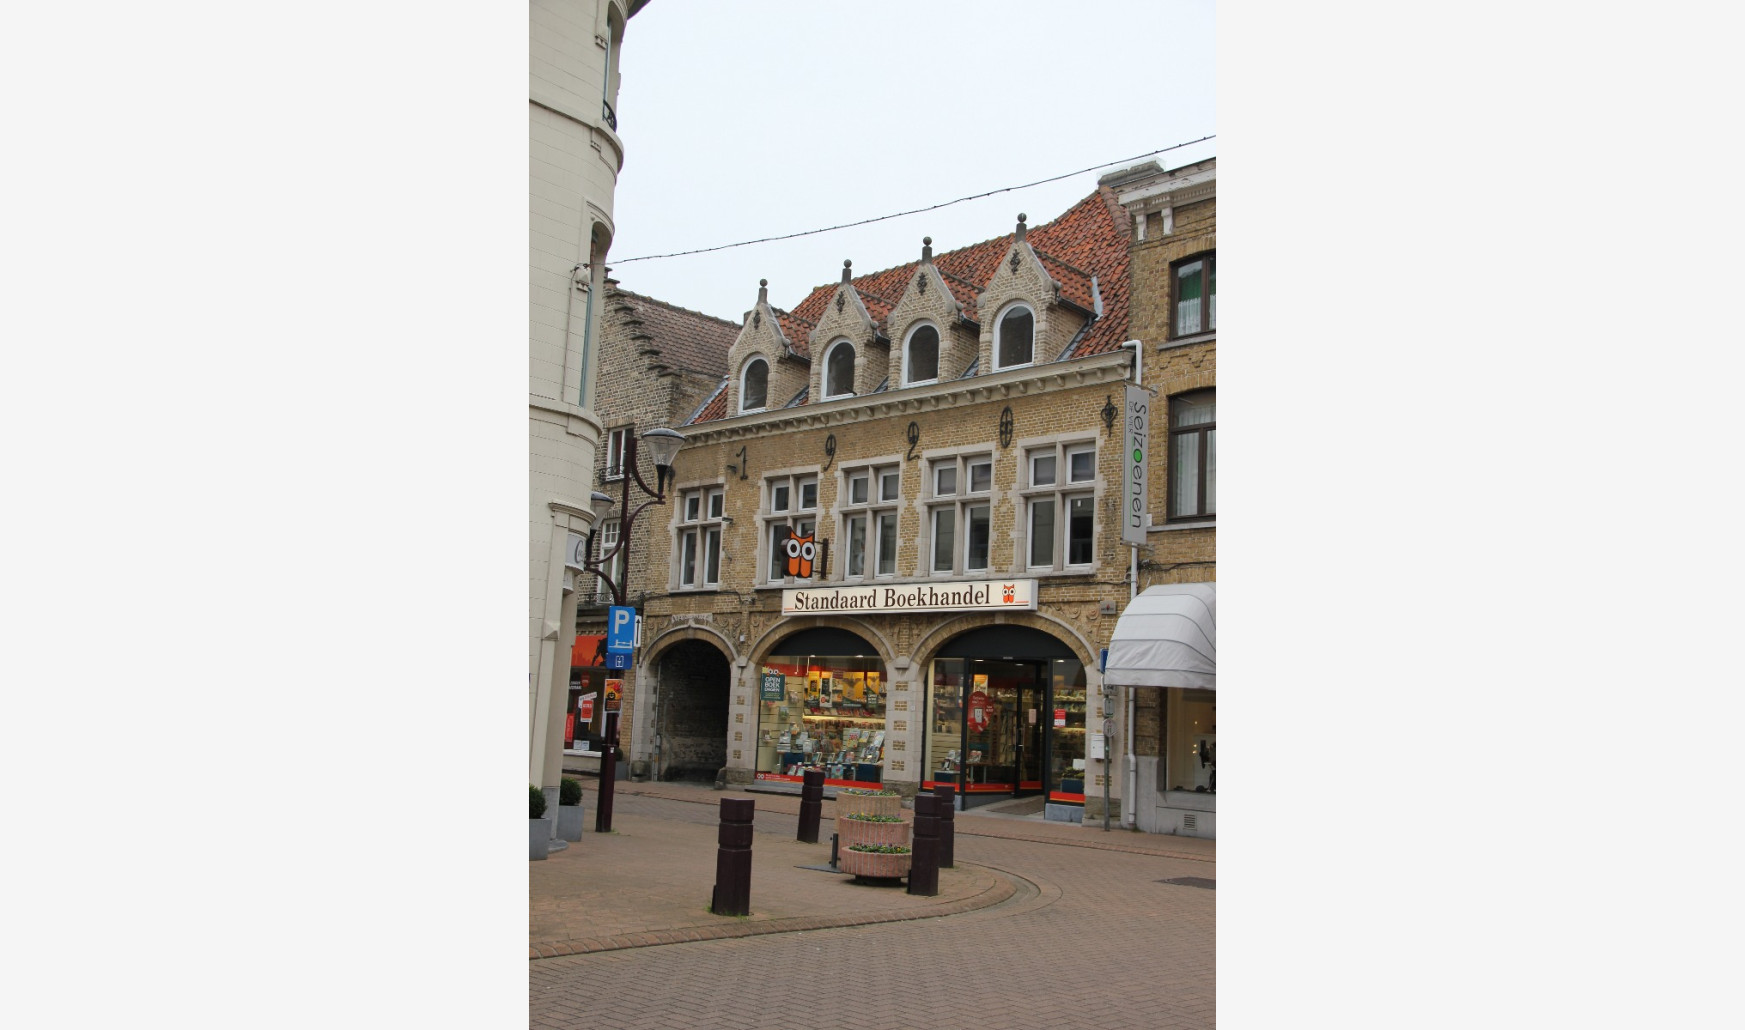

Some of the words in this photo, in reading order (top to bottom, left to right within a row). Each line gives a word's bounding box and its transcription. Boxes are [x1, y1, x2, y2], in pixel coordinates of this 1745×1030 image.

[1131, 401, 1147, 529] Seizoenen
[794, 588, 877, 610] Standaard
[884, 584, 990, 607] Boekhandel
[614, 609, 630, 634] P
